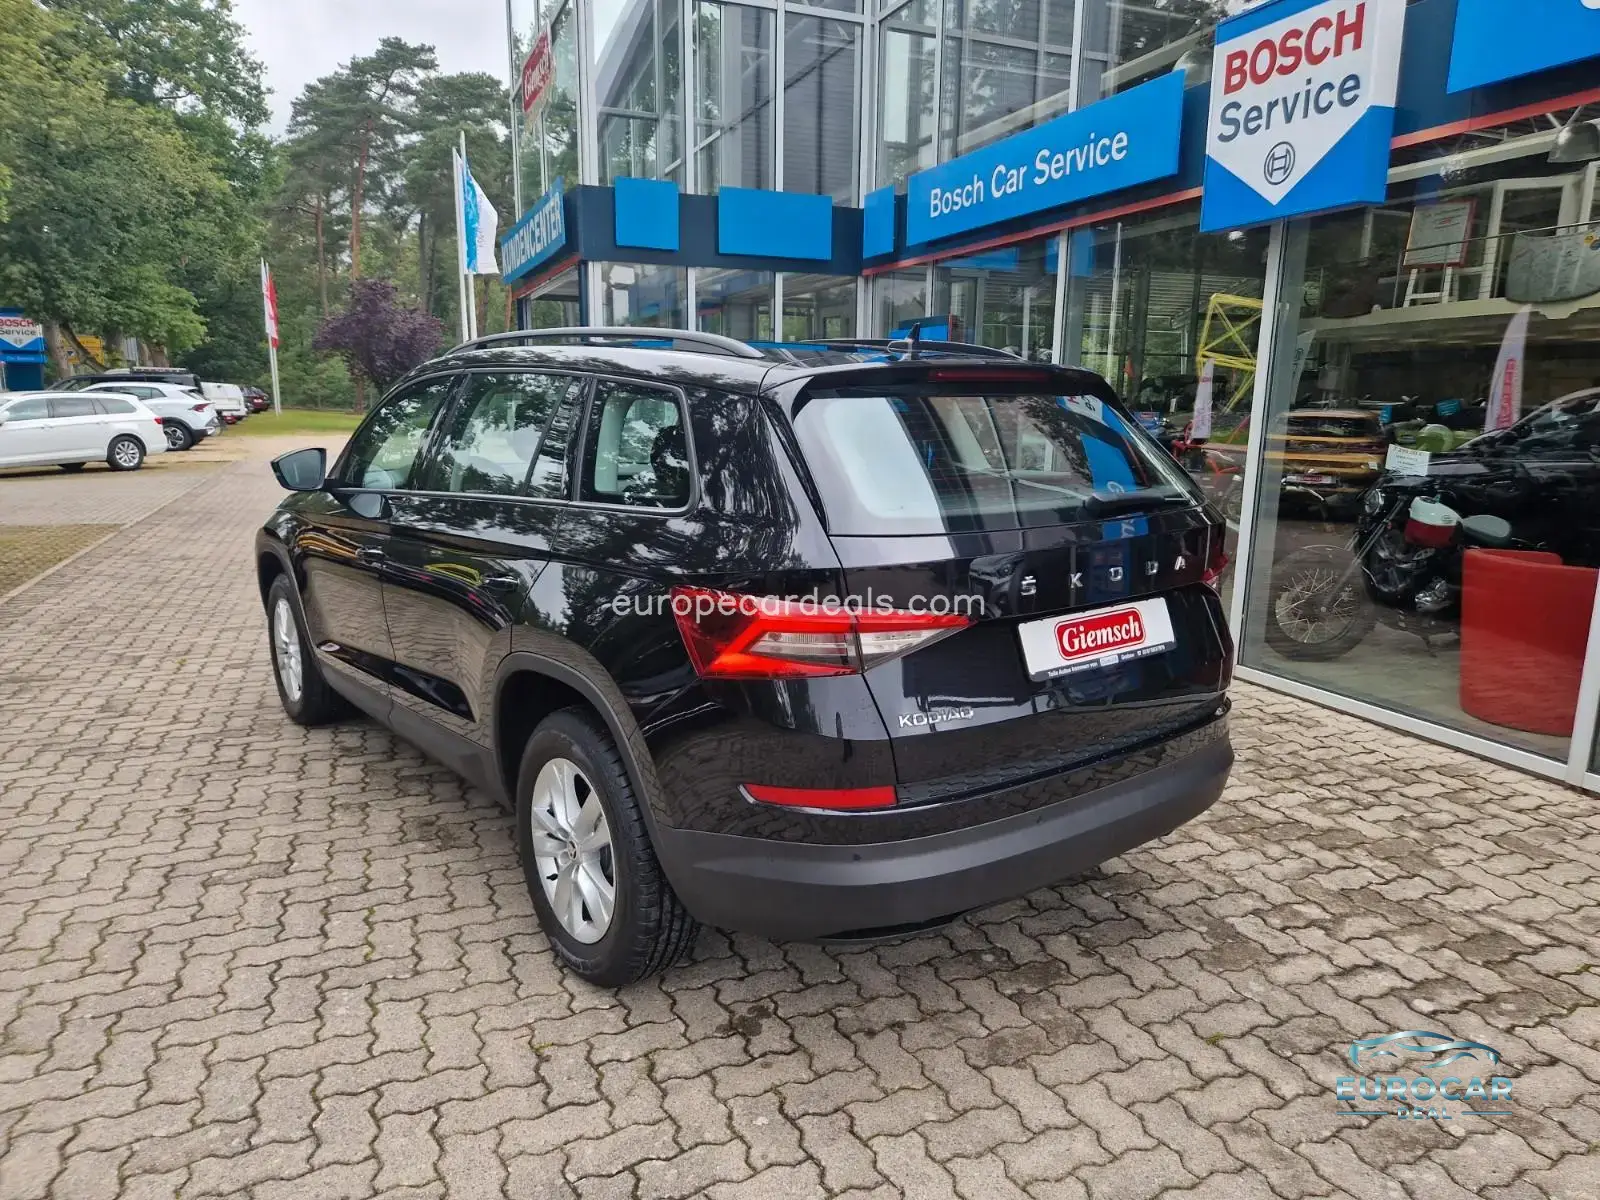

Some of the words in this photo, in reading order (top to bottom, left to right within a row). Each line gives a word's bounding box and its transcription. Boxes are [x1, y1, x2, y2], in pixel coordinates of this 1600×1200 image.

[1224, 2, 1366, 95] BOSCH
[1217, 73, 1361, 143] Service
[929, 174, 984, 218] Bosch
[991, 164, 1028, 198] Car
[1033, 131, 1129, 185] Service
[501, 191, 562, 277] KUNDENCENTER
[0, 328, 37, 336] Service
[1062, 615, 1141, 652] Giemsch
[898, 706, 974, 728] KODIAQ
